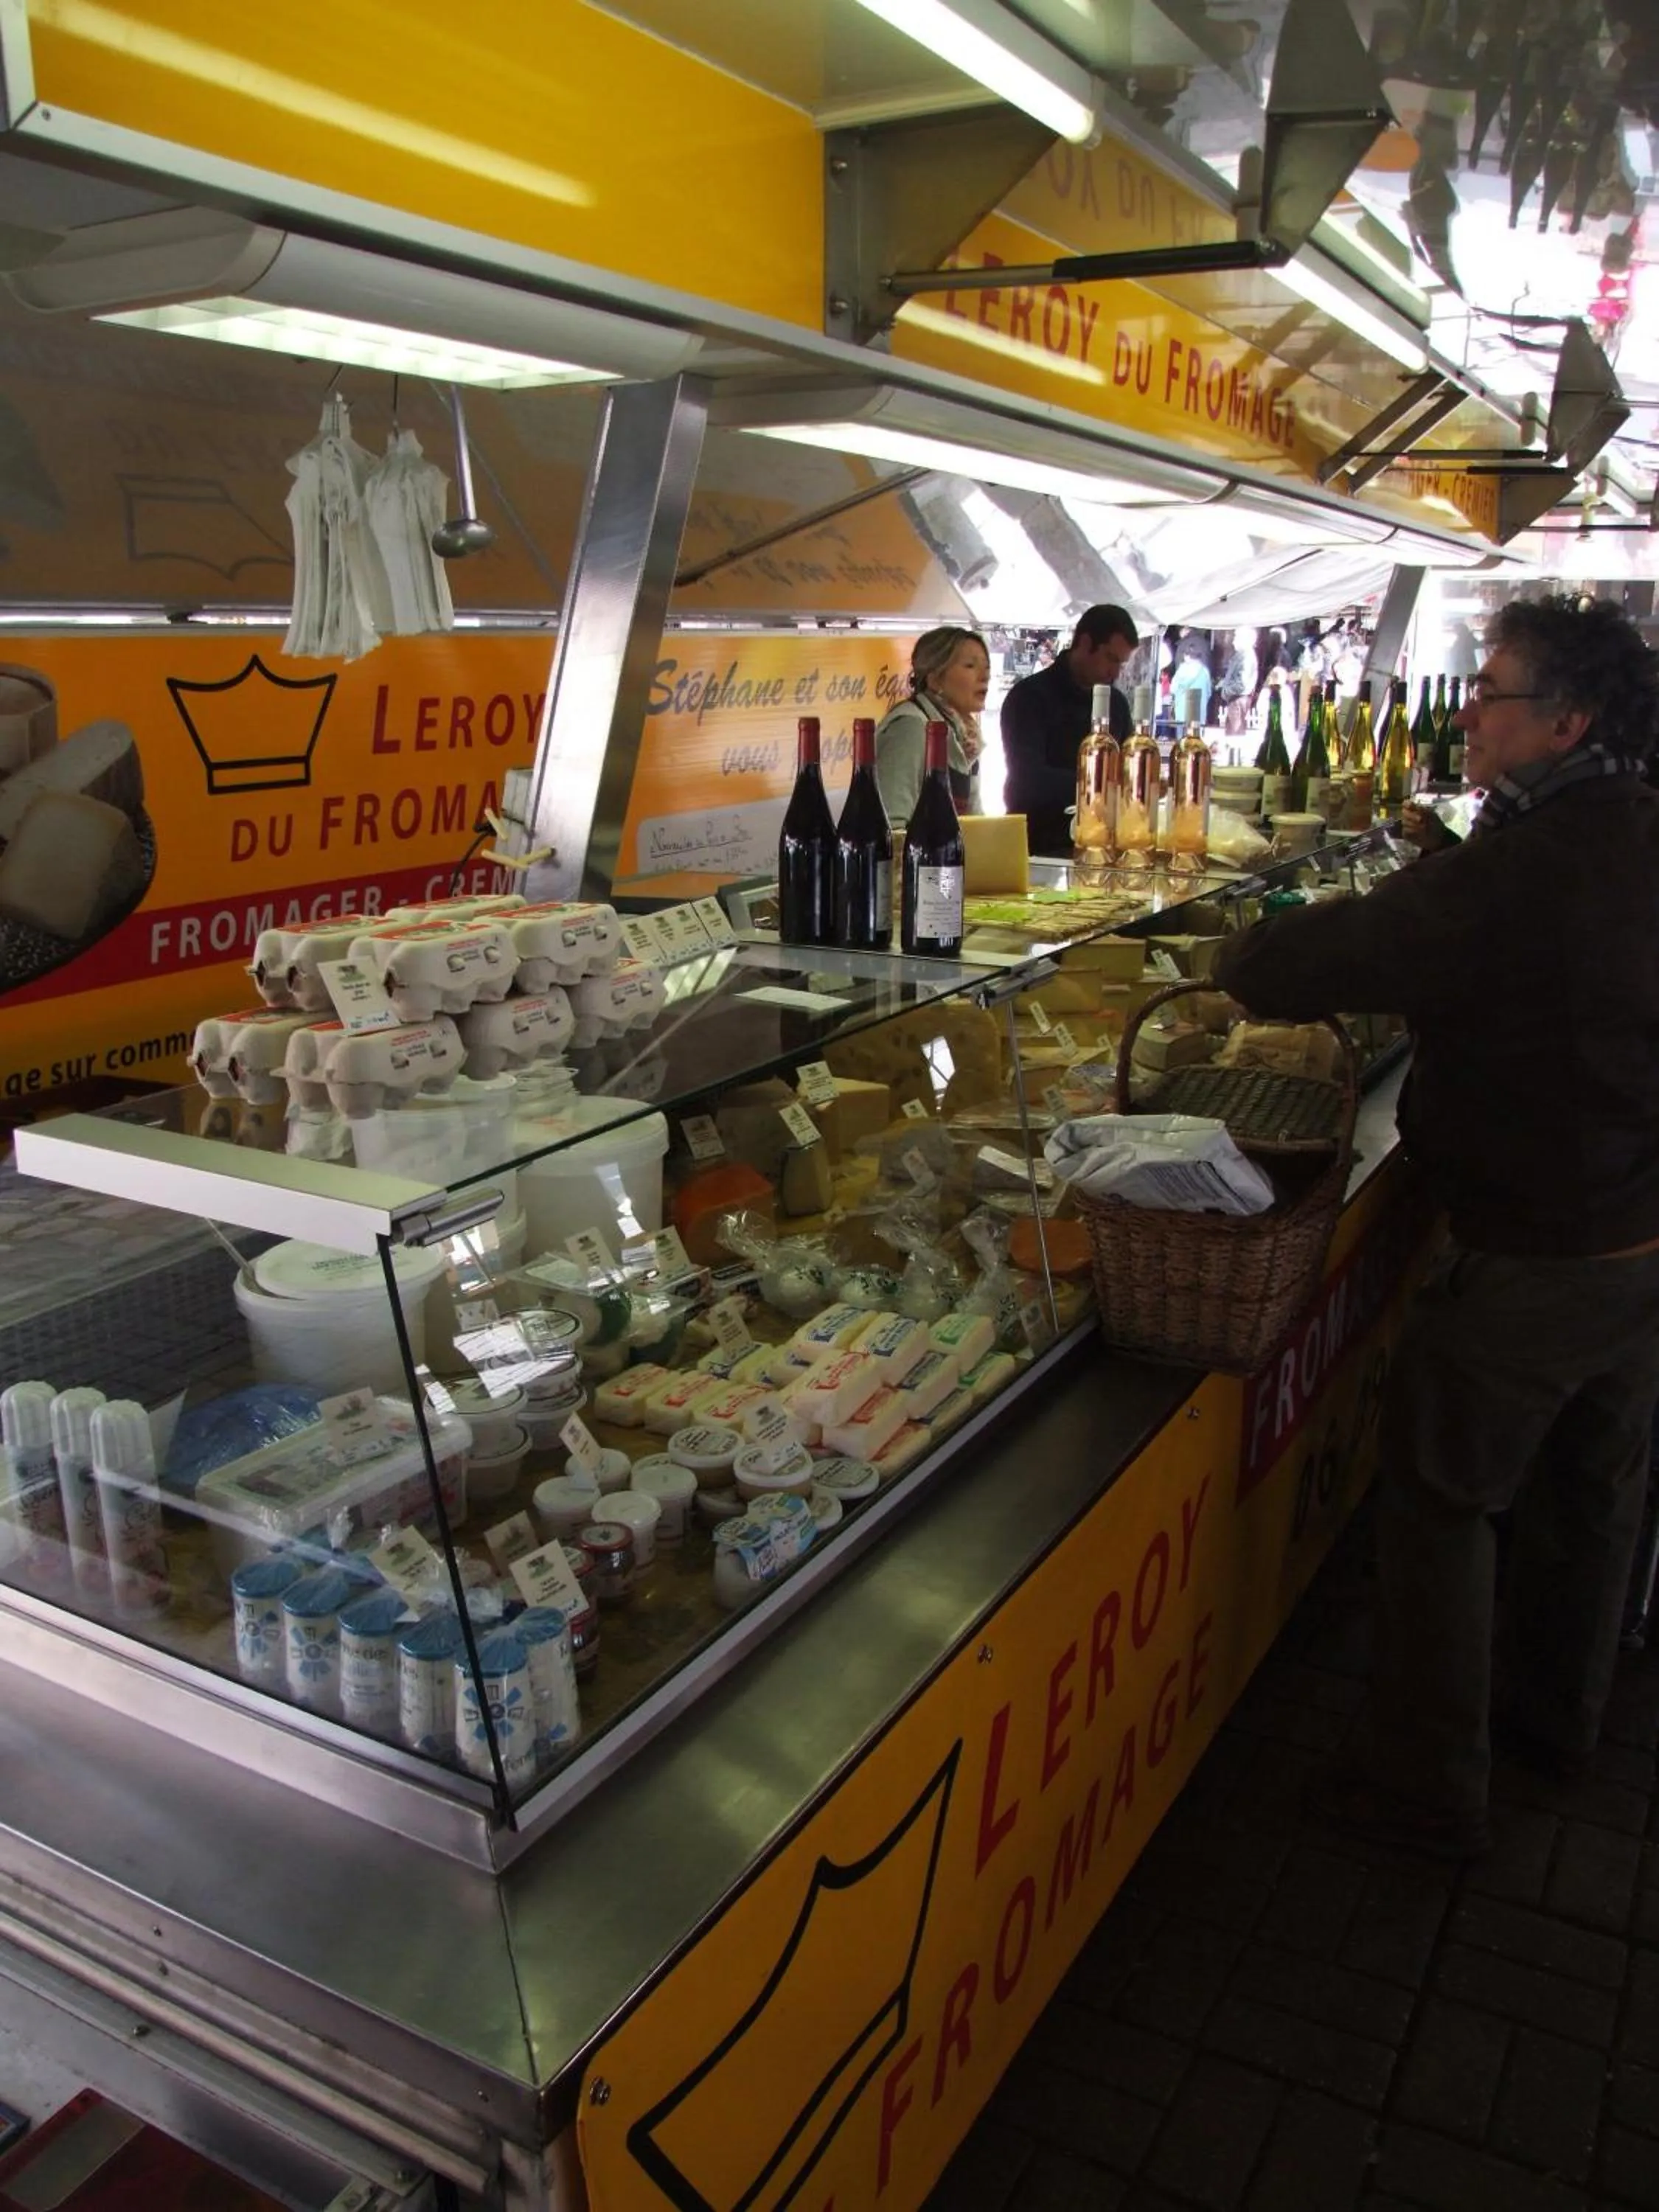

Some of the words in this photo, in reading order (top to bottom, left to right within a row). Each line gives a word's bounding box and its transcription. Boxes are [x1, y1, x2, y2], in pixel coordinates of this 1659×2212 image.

[944, 251, 1101, 367] LEROY
[1113, 331, 1152, 394] DU
[1165, 338, 1295, 448] FROMAGE
[373, 684, 546, 754] LEROY
[643, 658, 784, 726] Stéphane
[794, 667, 820, 705] et
[825, 672, 866, 702] son
[231, 813, 293, 863] DU
[50, 1052, 97, 1086] sur
[105, 1029, 197, 1071] comm
[974, 1475, 1210, 1882] LEROY
[876, 1610, 1214, 2199] FROMAGE
